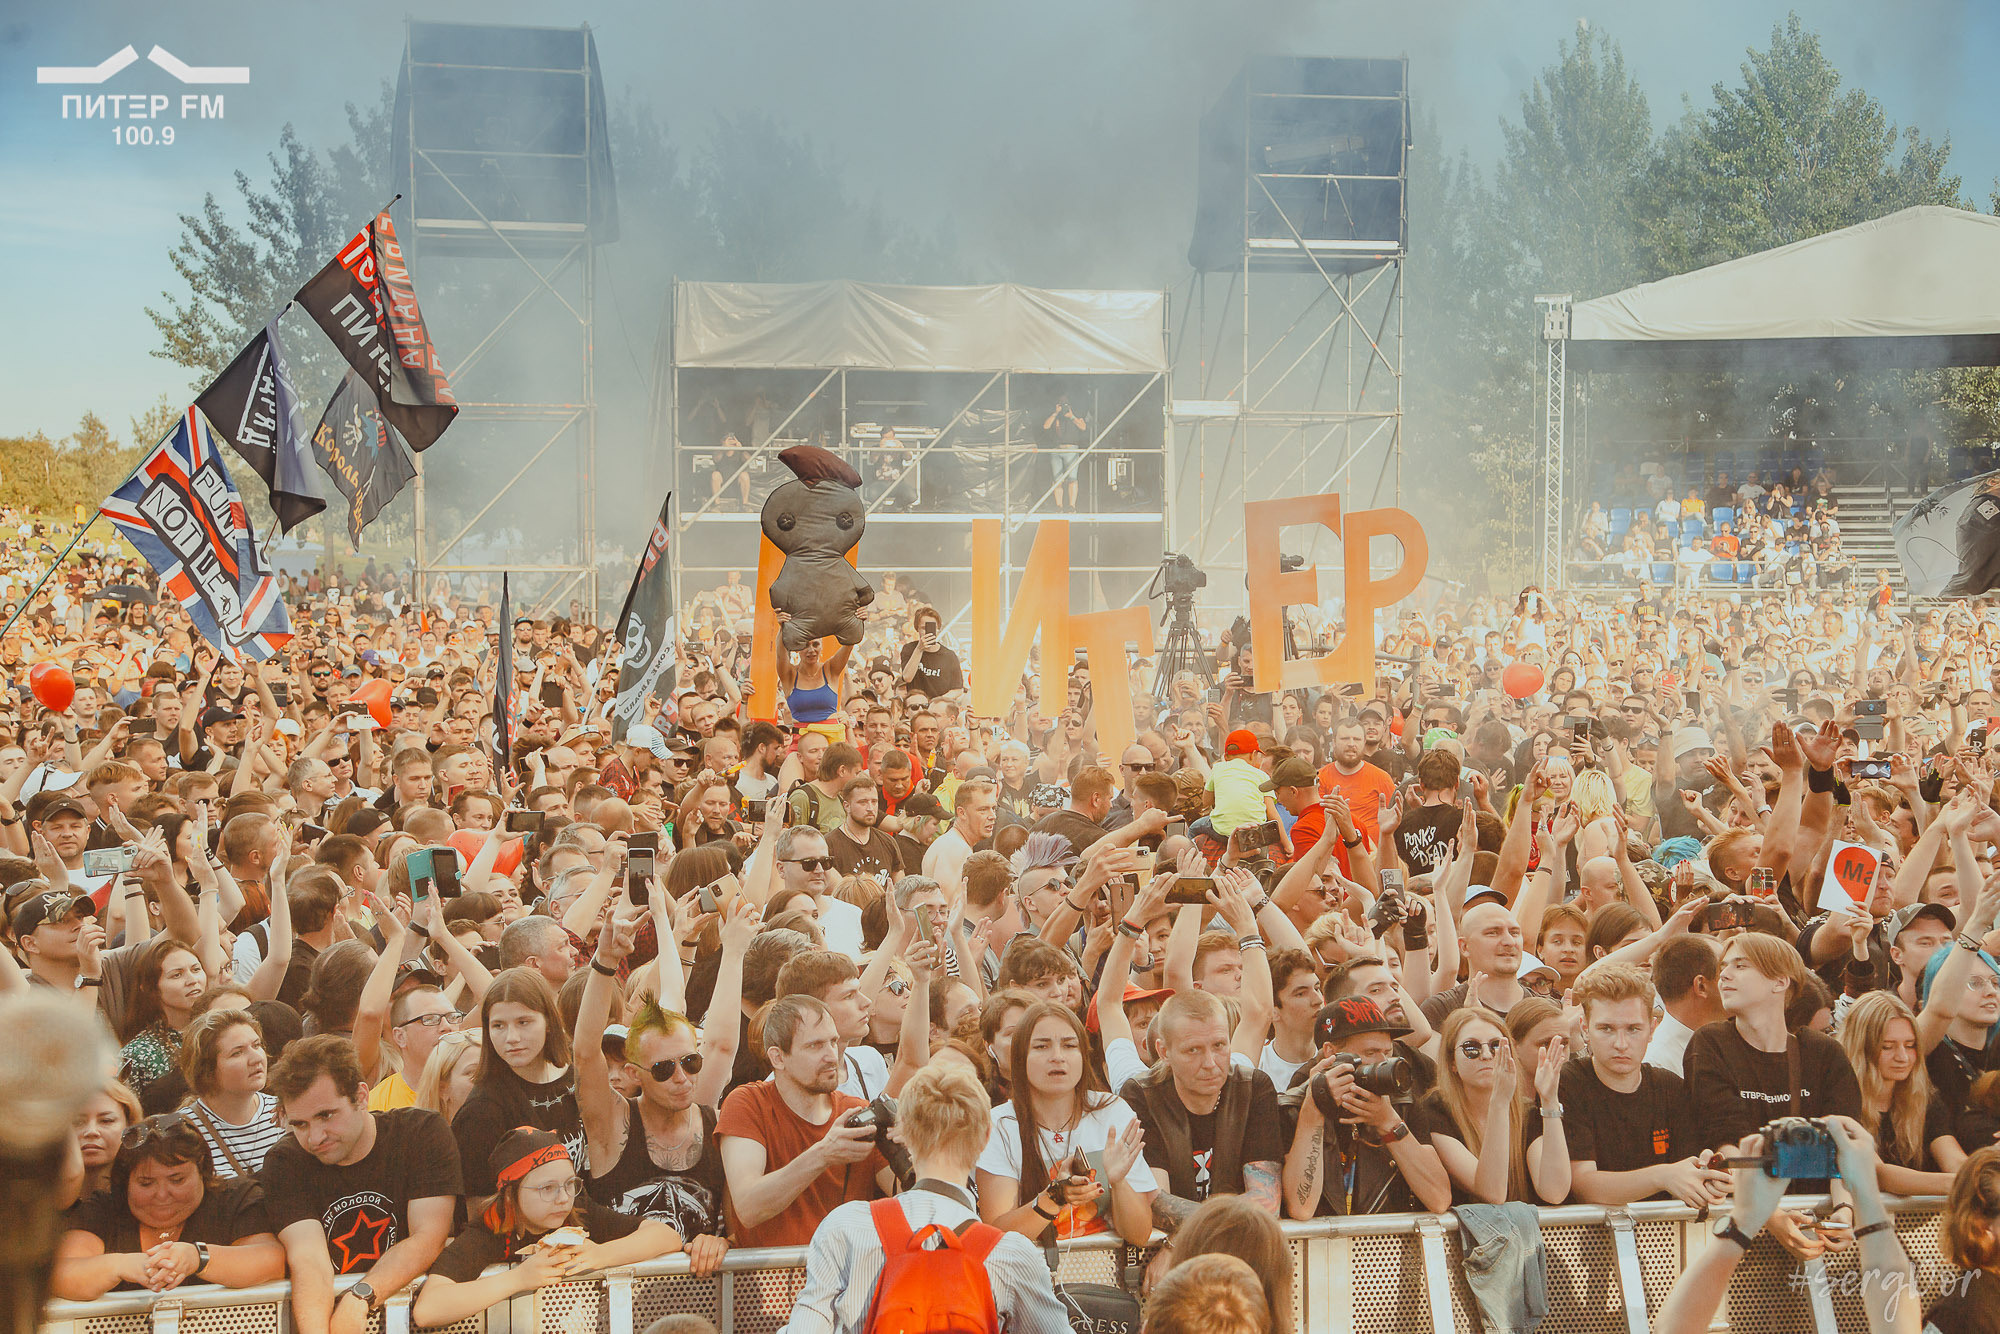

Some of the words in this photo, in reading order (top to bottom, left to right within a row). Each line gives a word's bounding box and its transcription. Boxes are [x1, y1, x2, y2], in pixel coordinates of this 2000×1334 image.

[145, 488, 201, 547] NOT
[1413, 840, 1450, 867] DEAD
[333, 1194, 382, 1213] МОЛОДОЙ
